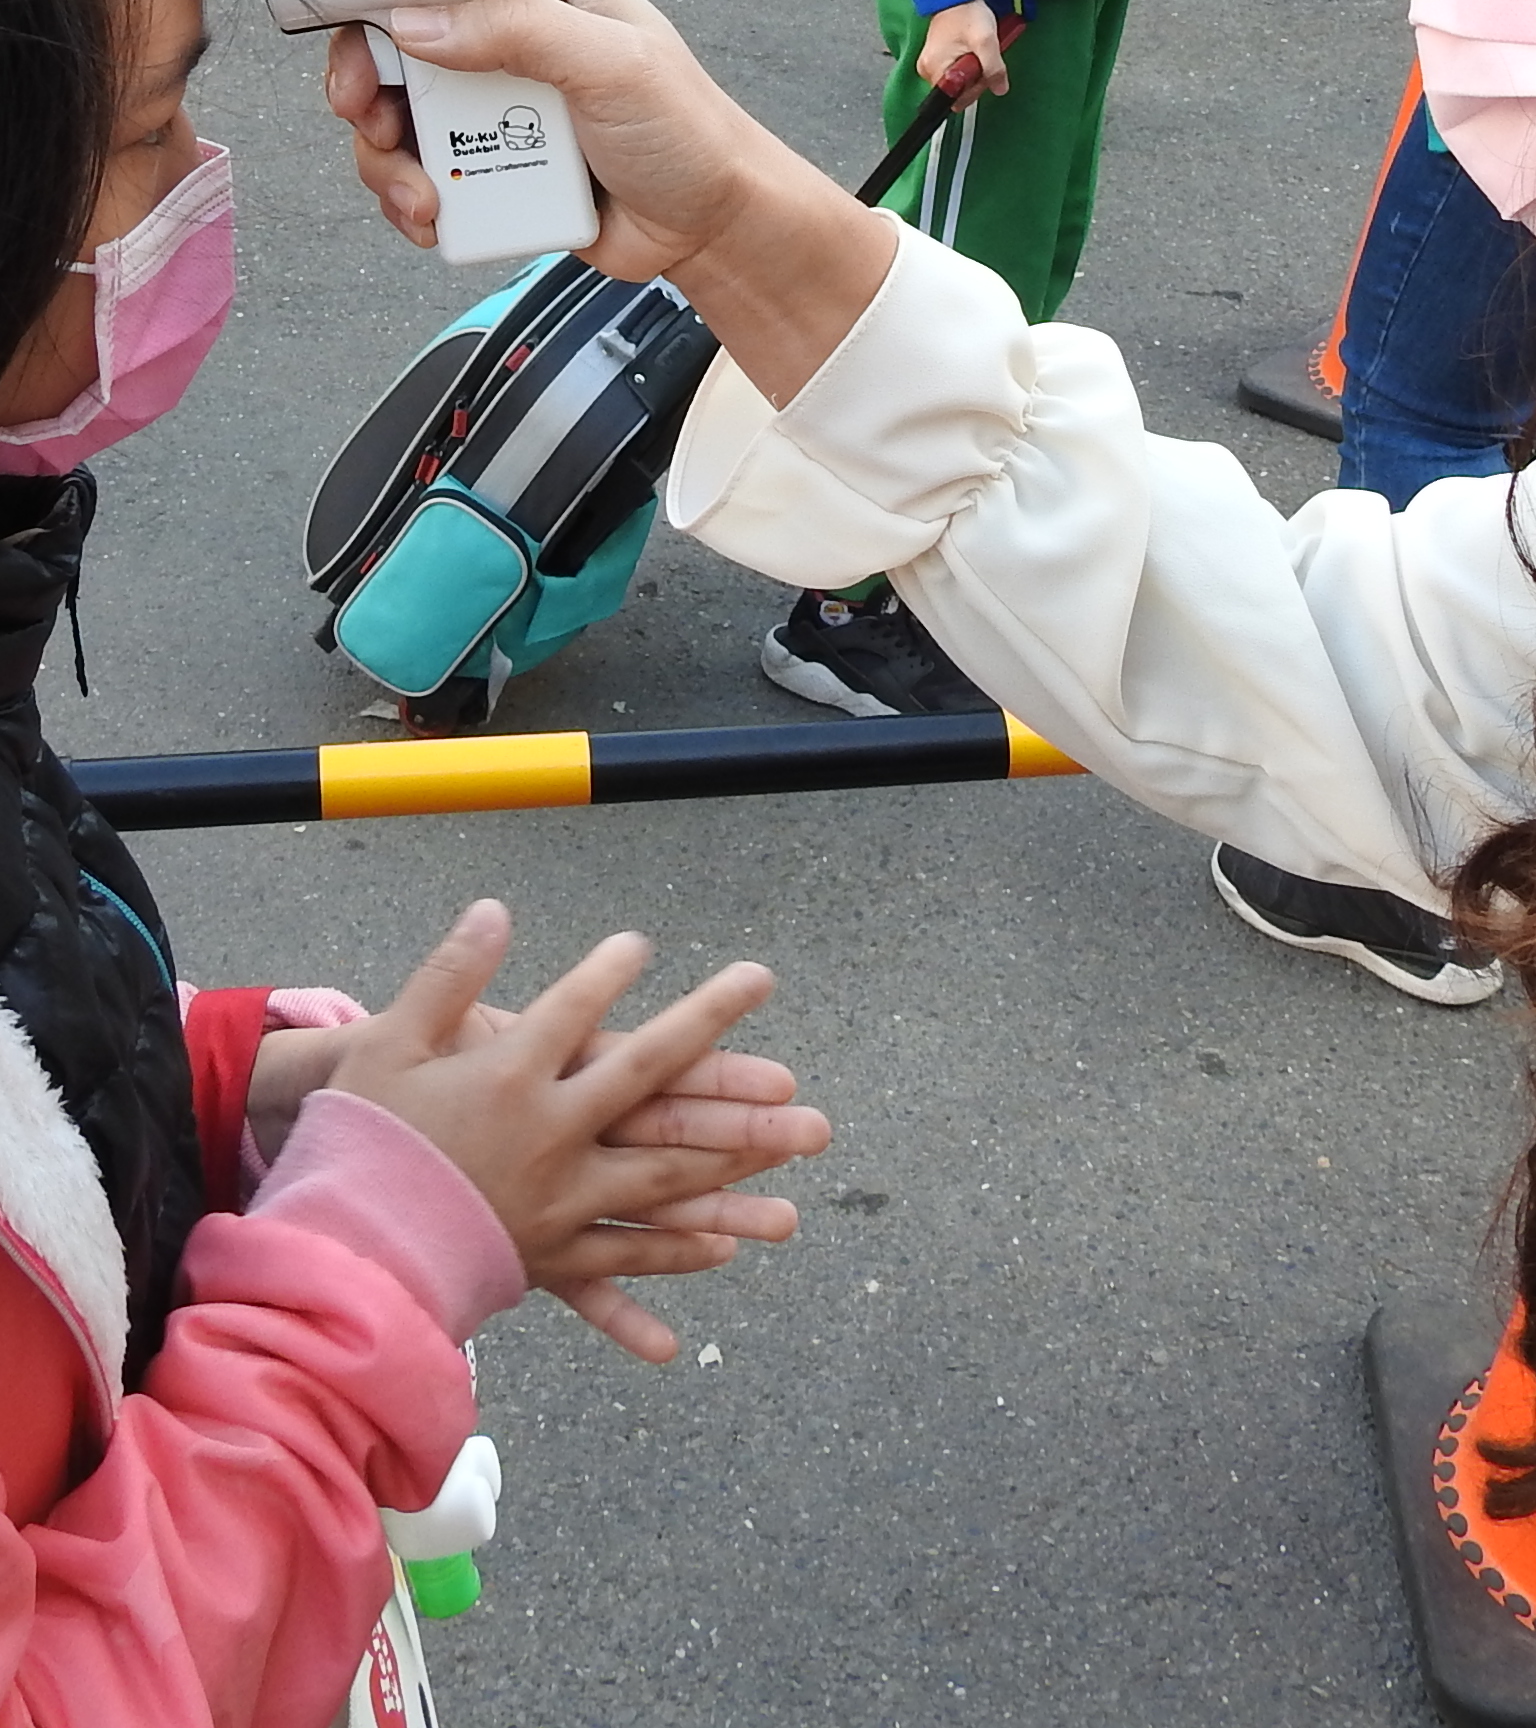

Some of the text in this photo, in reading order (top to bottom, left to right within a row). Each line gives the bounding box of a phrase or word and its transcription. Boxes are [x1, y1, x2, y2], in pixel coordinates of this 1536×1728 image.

[453, 144, 500, 157] Duckbill
[465, 158, 549, 177] German Craftsmanship
